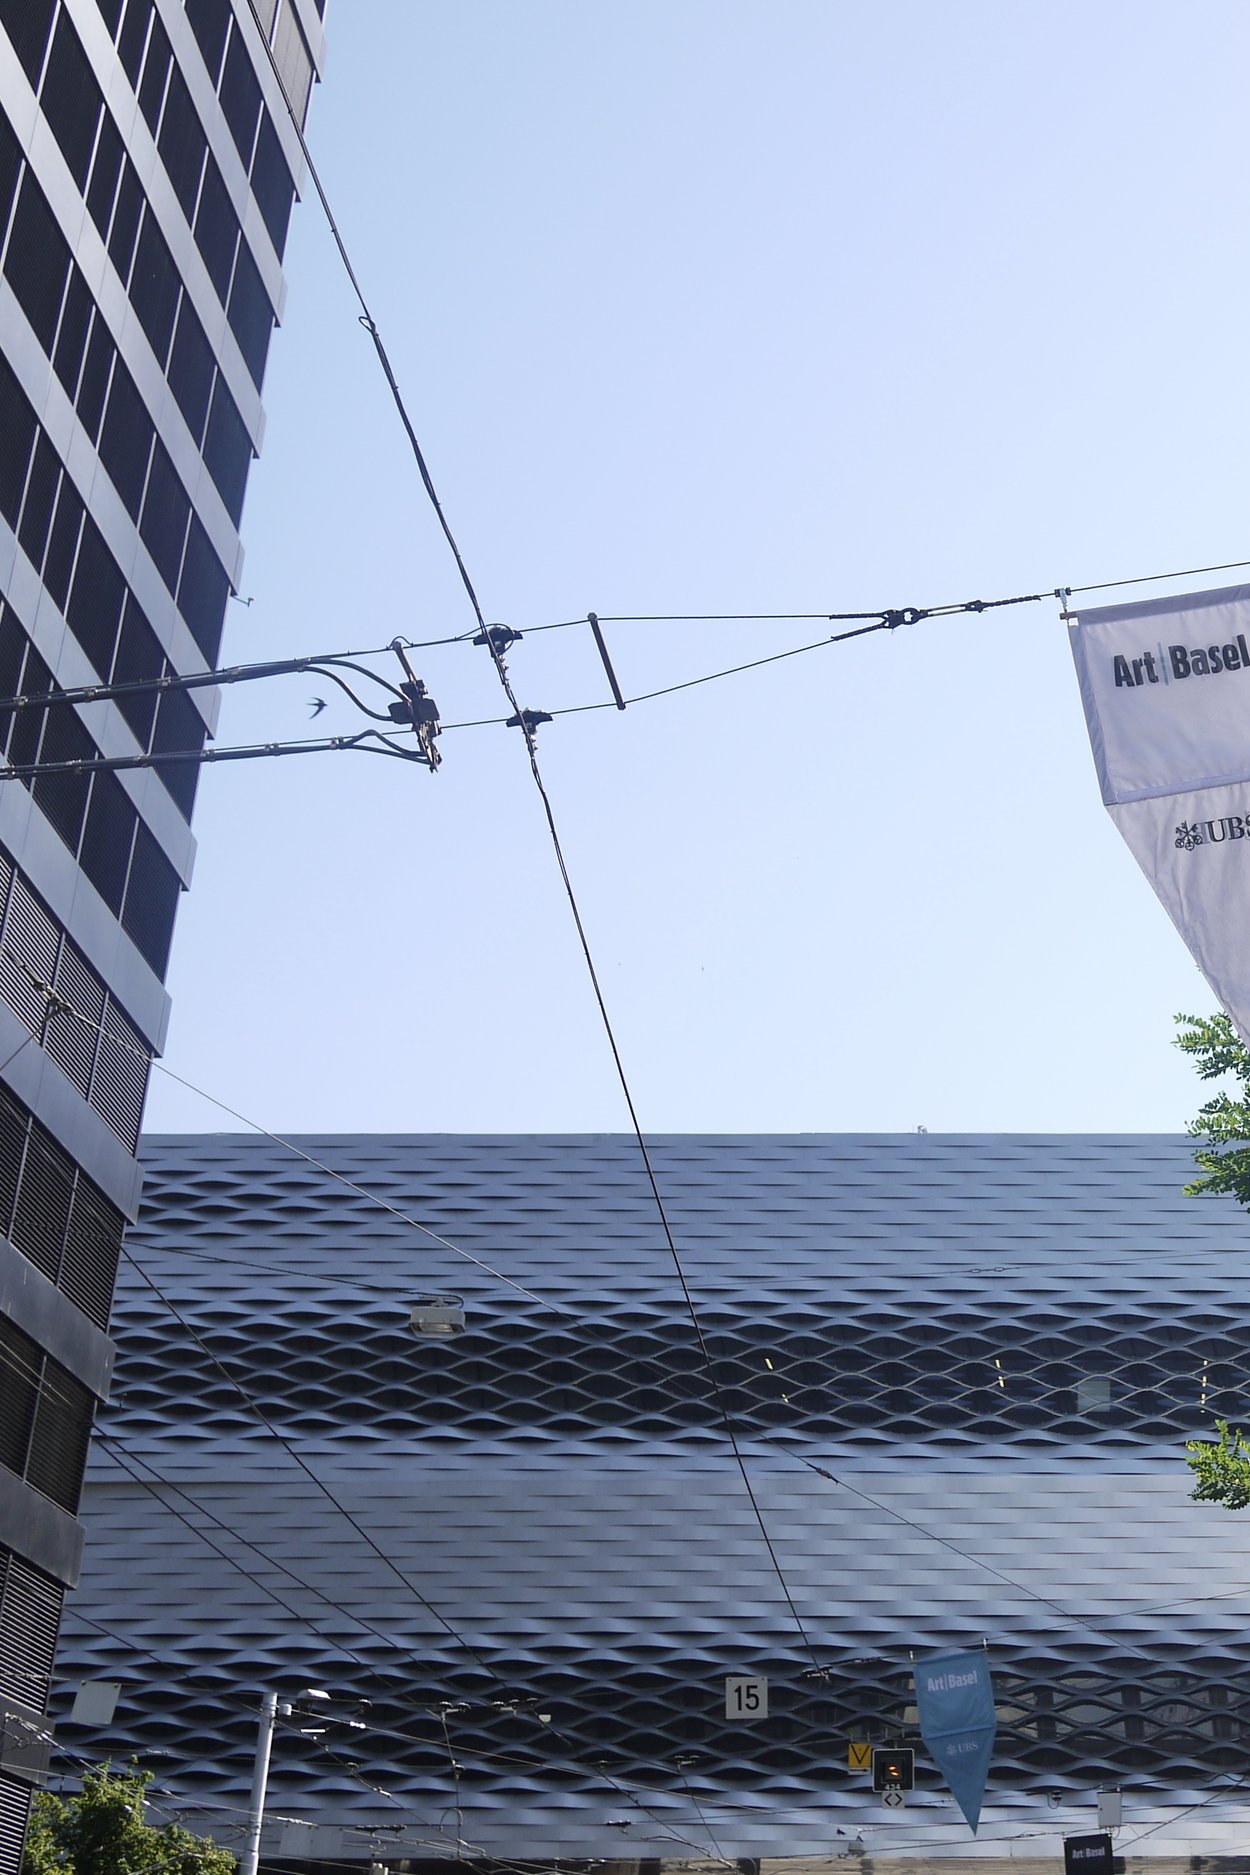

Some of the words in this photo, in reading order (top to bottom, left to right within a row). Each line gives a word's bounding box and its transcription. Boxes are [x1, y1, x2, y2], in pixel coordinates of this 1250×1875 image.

[1113, 651, 1160, 688] Art
[927, 1676, 945, 1692] Art
[948, 1669, 977, 1689] Basel
[734, 1685, 760, 1711] 15
[958, 1742, 978, 1753] UBS
